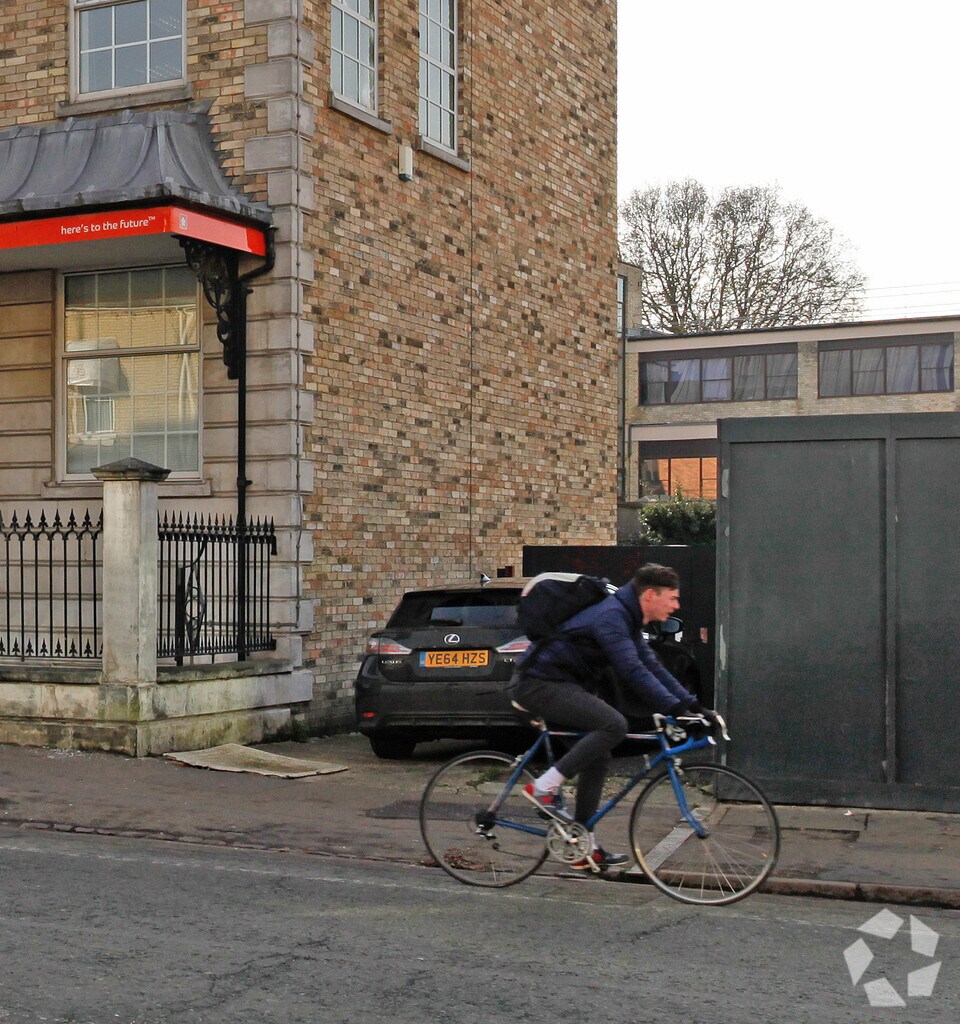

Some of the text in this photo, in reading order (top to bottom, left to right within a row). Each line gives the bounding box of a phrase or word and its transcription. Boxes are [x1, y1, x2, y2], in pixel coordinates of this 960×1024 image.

[60, 223, 89, 235] here's
[90, 223, 101, 232] to
[102, 221, 118, 231] the
[428, 651, 486, 665] YE64 HZS
